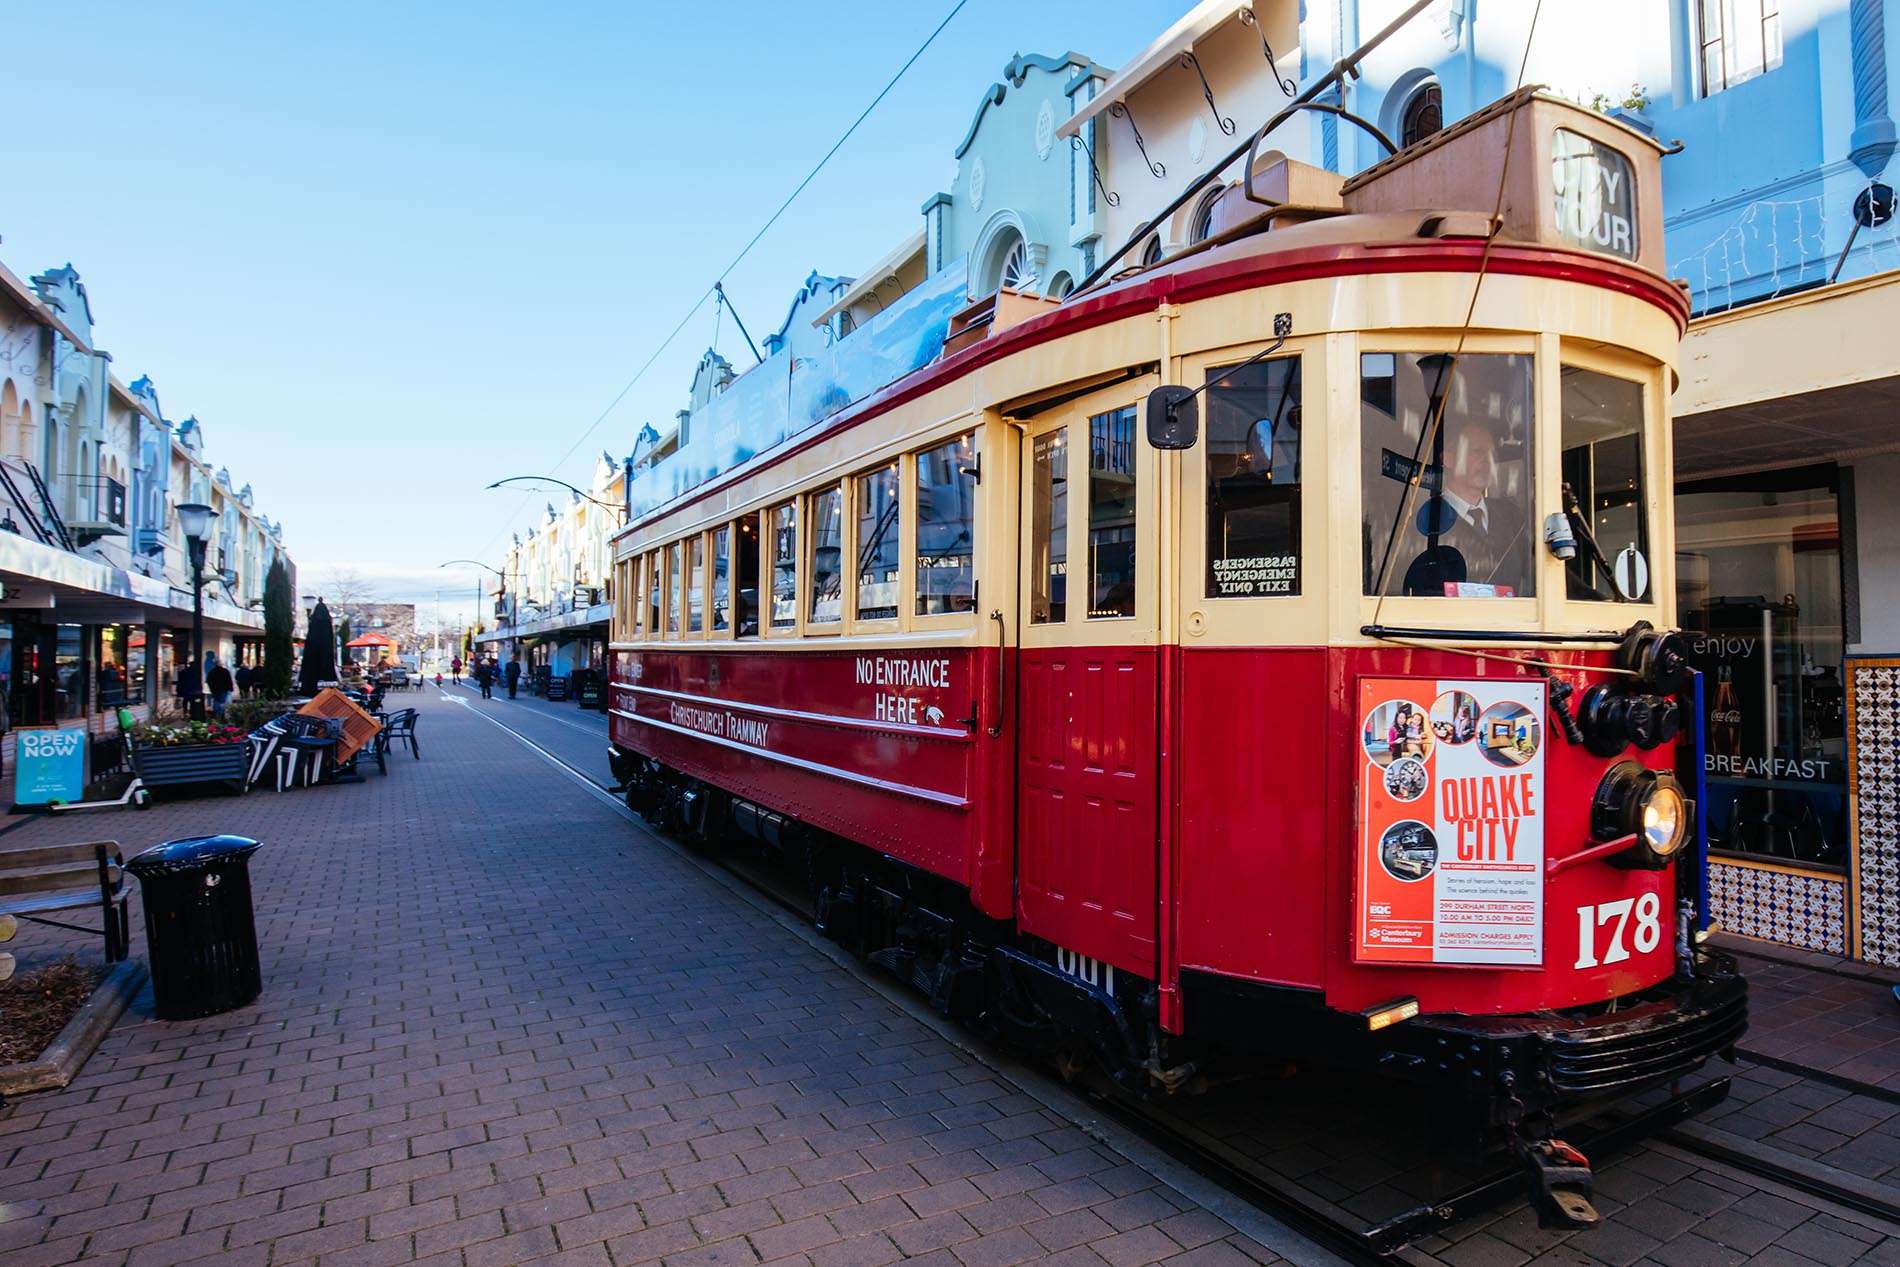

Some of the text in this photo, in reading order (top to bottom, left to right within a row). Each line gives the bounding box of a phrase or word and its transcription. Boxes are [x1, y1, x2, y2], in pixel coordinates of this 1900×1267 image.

[1693, 633, 1756, 658] enjoy
[876, 657, 950, 688] ENTRANCE
[875, 692, 918, 724] HERE
[671, 701, 724, 736] CHRISTCHURCH
[725, 711, 769, 747] TRAMWAY
[23, 734, 79, 747] OPEN
[24, 745, 76, 758] NOW
[1704, 754, 1830, 780] BREAKFAST
[1441, 773, 1536, 825] QUAKE
[1457, 818, 1520, 861] CITY
[1455, 902, 1485, 910] DURHAM
[1380, 928, 1423, 938] Canterbury
[1439, 931, 1478, 939] ADMISSION
[1480, 932, 1512, 940] CHARGES
[1574, 892, 1661, 970] 178
